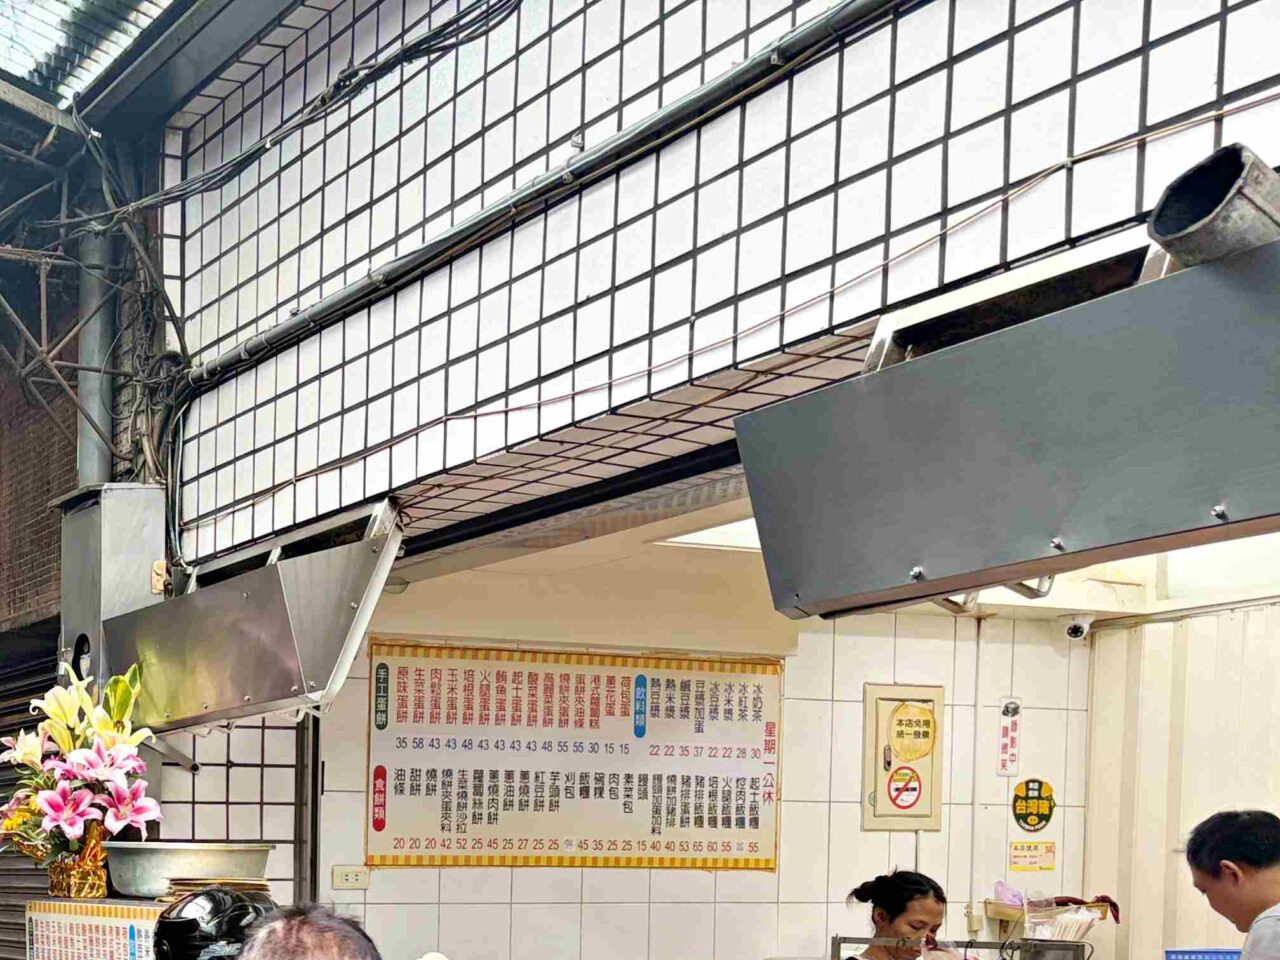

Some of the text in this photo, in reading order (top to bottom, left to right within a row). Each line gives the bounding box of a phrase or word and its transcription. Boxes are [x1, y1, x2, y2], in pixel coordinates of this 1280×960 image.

[376, 668, 388, 725] 手工蛋餅
[396, 666, 408, 724] 原味蛋餅
[413, 667, 425, 724] 生菜蛋餅
[446, 668, 458, 725] 玉米蛋餅
[462, 669, 475, 725] 培根蛋餅
[479, 669, 490, 726] 火腿蛋餅
[511, 671, 523, 727] 起士蛋餅
[620, 676, 631, 717] 荷包蛋
[635, 687, 646, 726] 飲料類
[738, 682, 748, 722] 冰紅茶
[752, 684, 762, 722] 冰奶茶
[897, 719, 930, 728] 本店免用
[896, 730, 929, 739] 統一發票
[396, 737, 407, 749] 35
[412, 737, 424, 749] 58
[428, 738, 440, 750] 43
[445, 738, 457, 750] 43
[462, 739, 473, 751] 48
[478, 739, 489, 751] 43
[494, 740, 505, 752] 43
[510, 740, 522, 752] 43
[526, 741, 537, 753] 43
[542, 741, 552, 753] 48
[557, 742, 568, 754] 55
[572, 742, 584, 754] 55
[588, 743, 599, 755] 30
[605, 743, 615, 755] 15
[620, 744, 630, 756] 15
[650, 745, 660, 757] 22
[664, 745, 674, 757] 22
[679, 746, 690, 758] 35
[693, 746, 704, 758] 37
[708, 747, 718, 759] 22
[722, 747, 732, 759] 22
[736, 748, 747, 760] 28
[751, 748, 761, 760] 30
[763, 721, 776, 805] 星期一公休
[394, 768, 406, 796] 油條
[410, 768, 421, 796] 甜餅
[426, 768, 437, 796] 燒餅
[564, 772, 576, 799] 刈包
[579, 772, 590, 799] 飯糰
[608, 773, 619, 800] 肉包
[637, 773, 648, 800] 饅頭
[534, 771, 545, 812] 紅豆餅
[548, 772, 560, 812] 芋頭餅
[622, 773, 634, 814] 素菜包
[680, 775, 691, 828] 豬排蛋餅
[708, 776, 718, 828] 培根飯糰
[394, 838, 404, 849] 20
[409, 838, 420, 849] 20
[425, 838, 436, 849] 20
[440, 838, 452, 849] 42
[456, 838, 468, 850] 52
[472, 838, 483, 850] 25
[487, 839, 498, 850] 45
[502, 839, 514, 850] 25
[518, 839, 528, 850] 27
[533, 839, 544, 851] 25
[548, 839, 559, 851] 25
[578, 840, 588, 851] 45
[592, 840, 603, 851] 35
[607, 840, 618, 852] 25
[622, 840, 632, 852] 25
[637, 841, 646, 852] 15
[650, 841, 660, 852] 40
[664, 841, 675, 852] 40
[679, 841, 689, 852] 53
[693, 841, 703, 853] 65
[708, 841, 718, 853] 60
[722, 842, 732, 853] 55
[748, 842, 758, 853] 55
